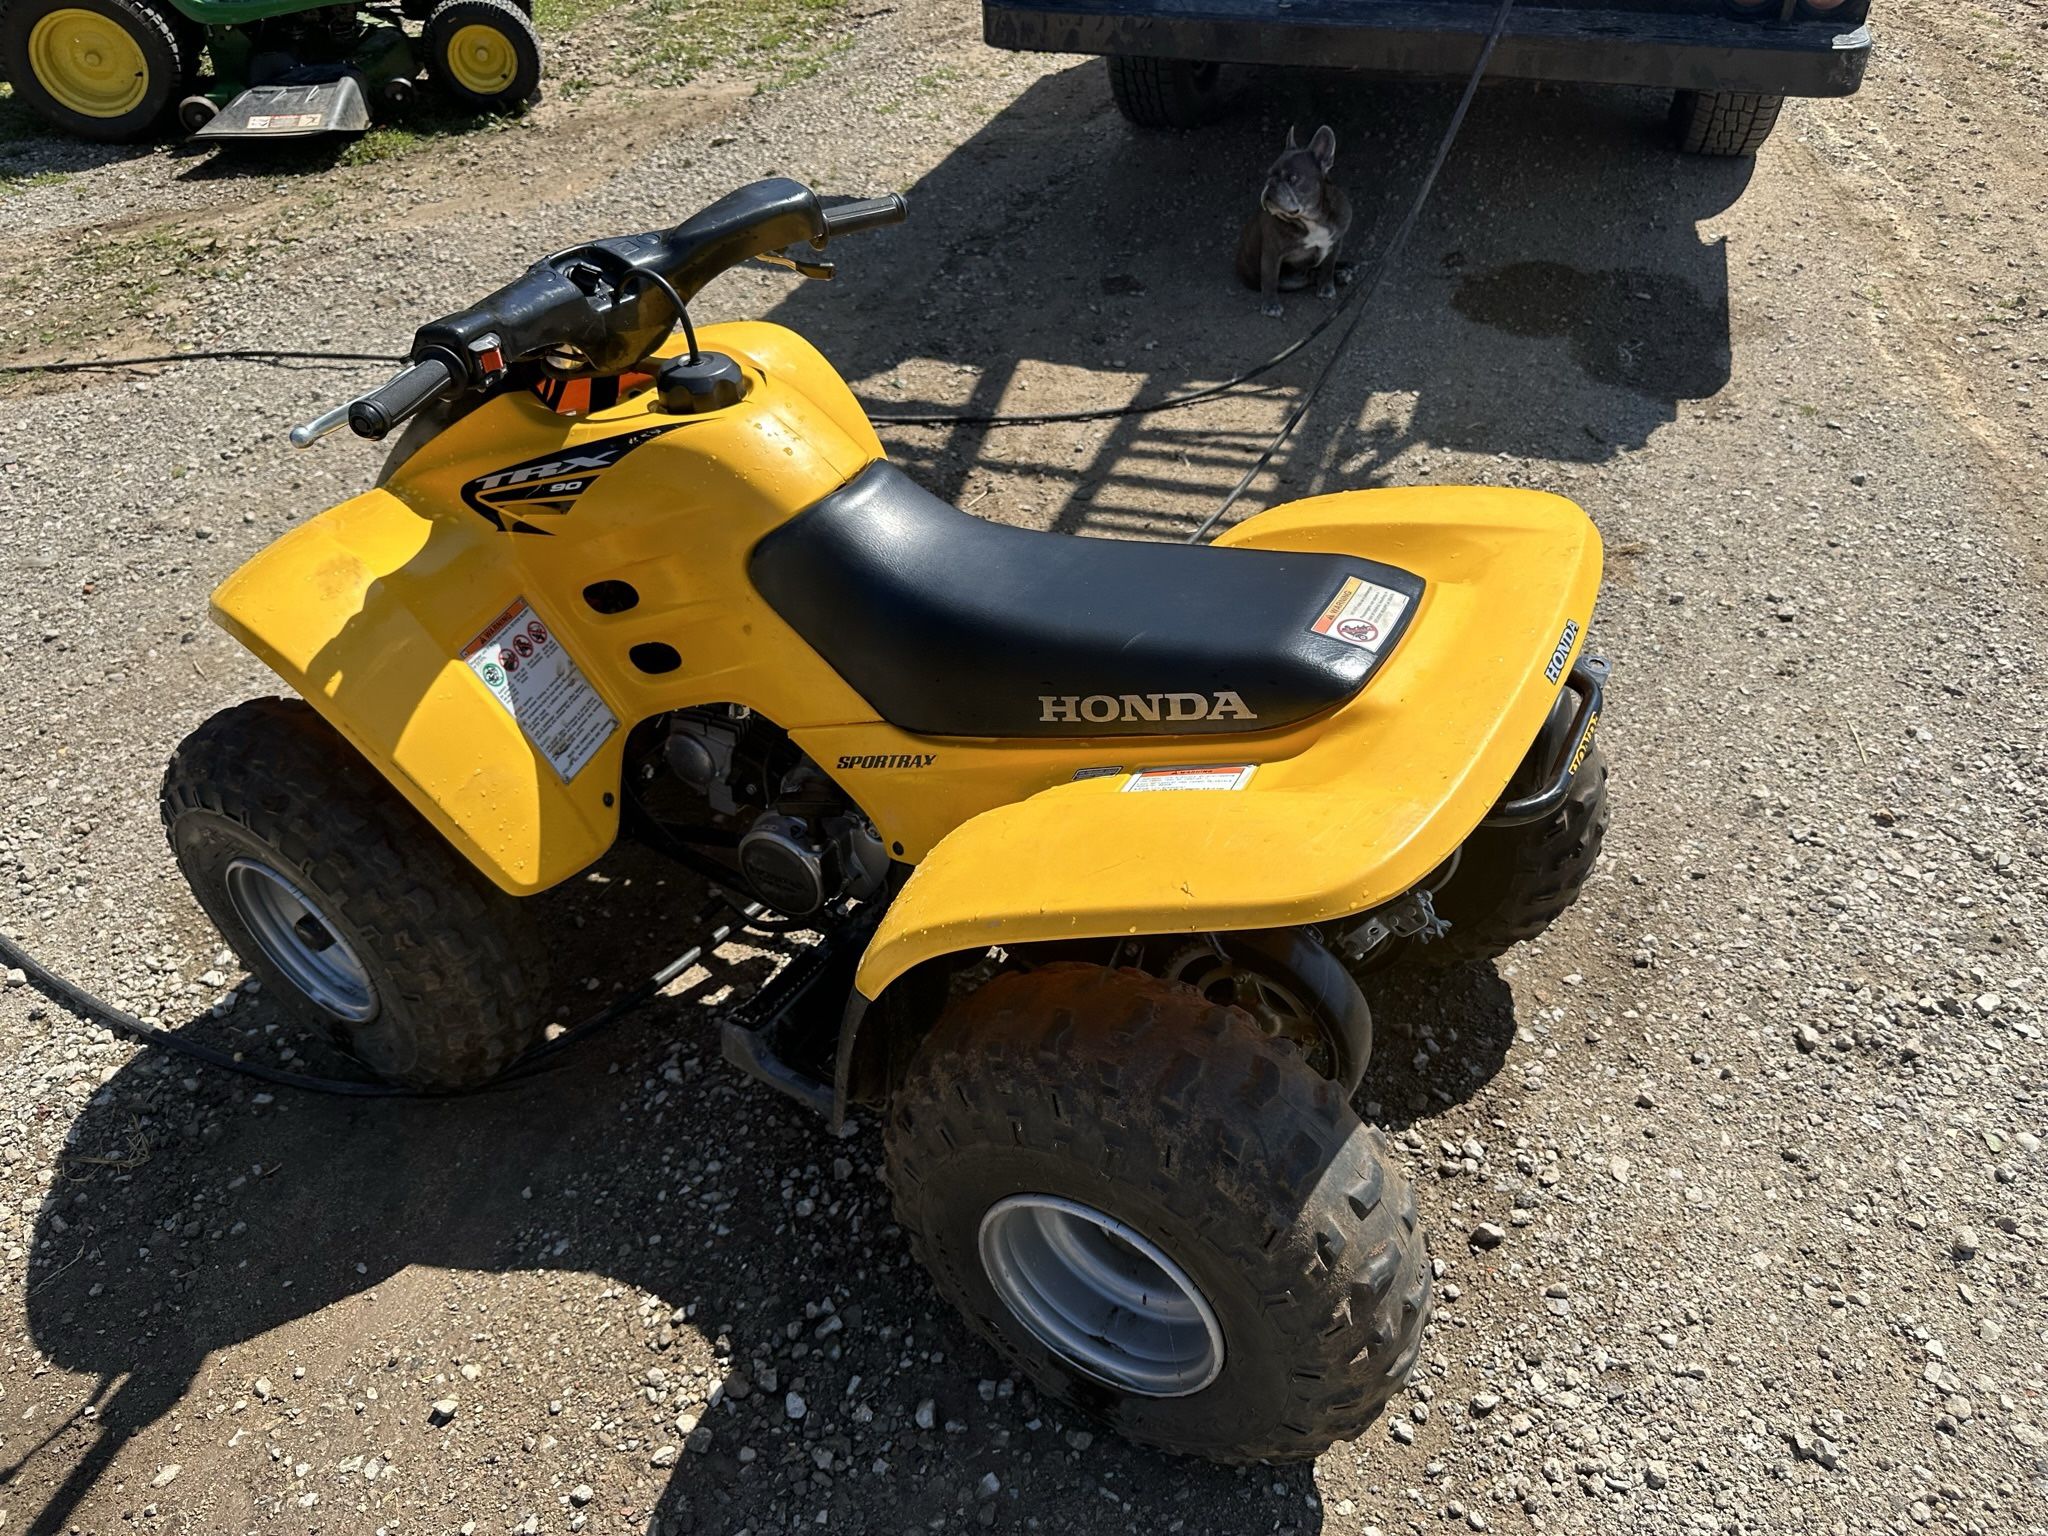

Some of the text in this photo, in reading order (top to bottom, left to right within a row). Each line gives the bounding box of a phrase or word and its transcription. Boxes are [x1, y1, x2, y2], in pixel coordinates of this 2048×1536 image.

[476, 450, 619, 490] TRX
[550, 481, 583, 492] 90
[1332, 590, 1352, 616] WARNING
[1545, 620, 1578, 684] HONDA
[1038, 691, 1258, 722] HONDA
[837, 755, 936, 769] SPORTRAX
